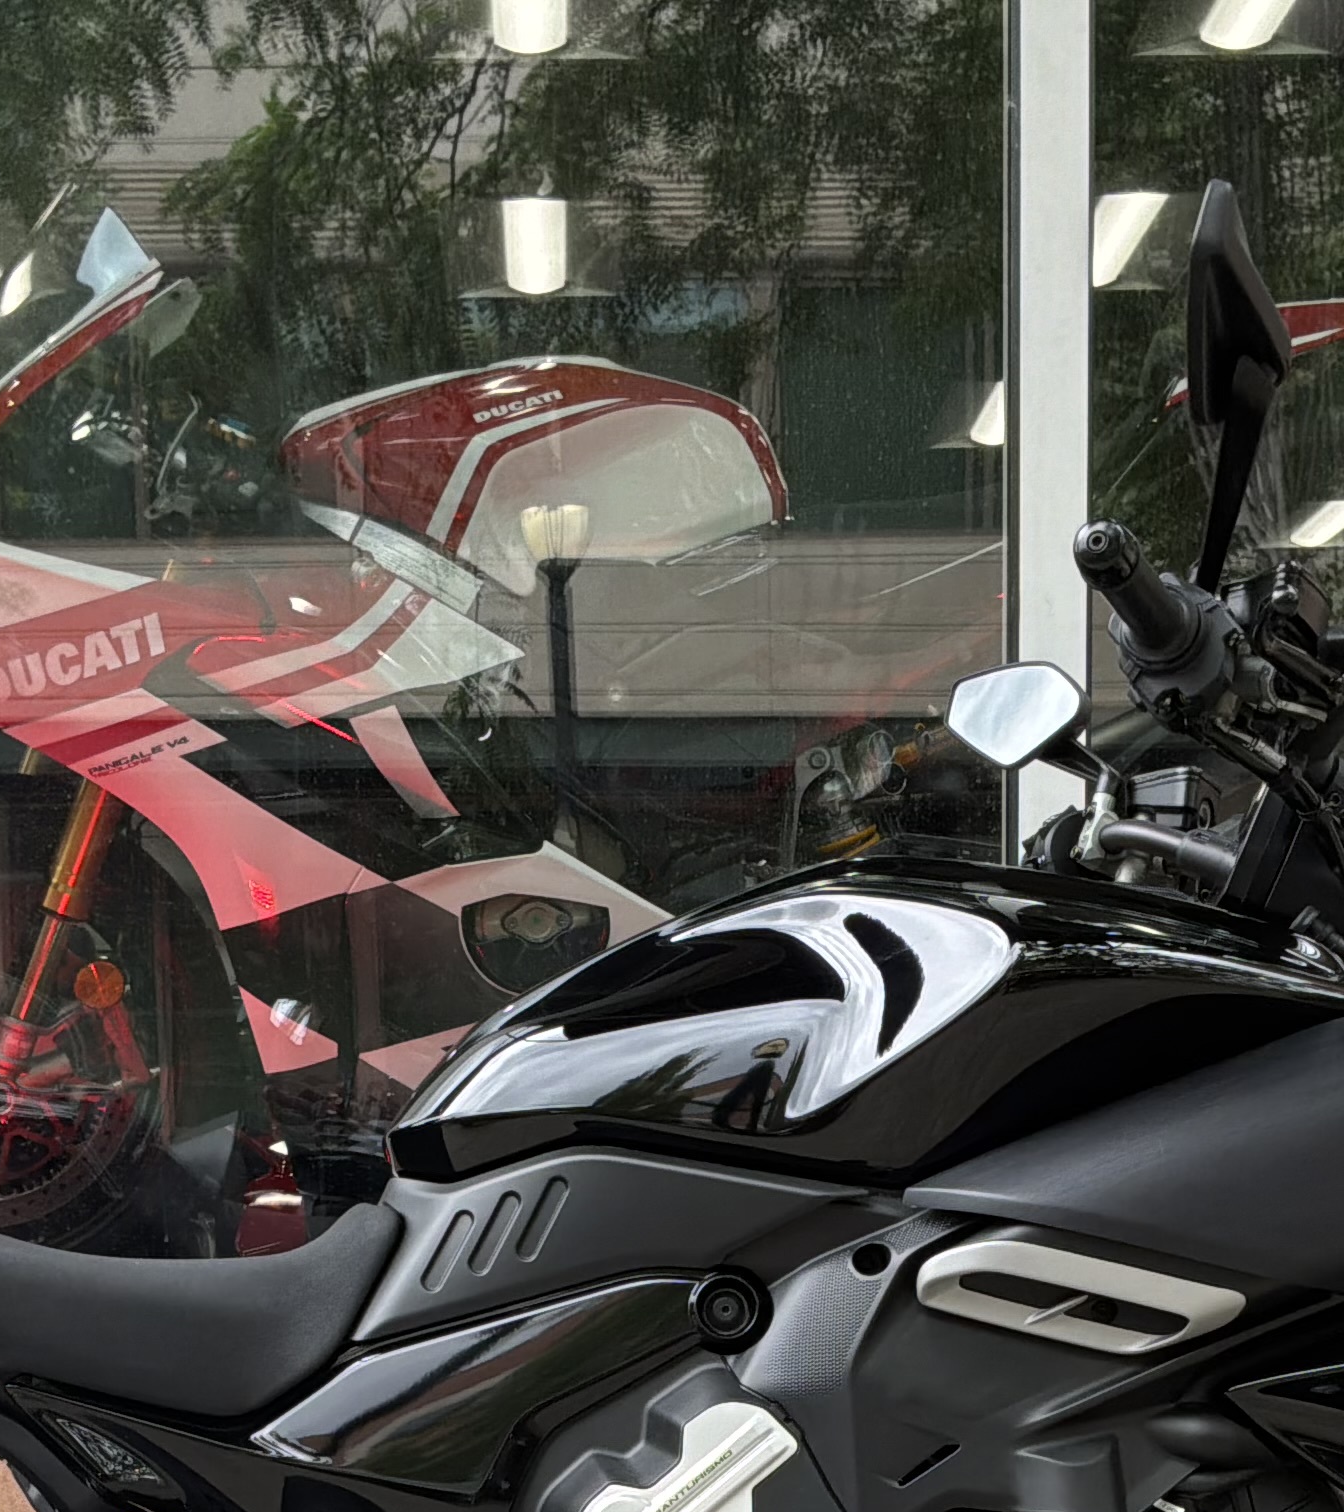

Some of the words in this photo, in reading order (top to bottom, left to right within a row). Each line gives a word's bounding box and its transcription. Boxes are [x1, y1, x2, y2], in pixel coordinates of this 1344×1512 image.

[472, 389, 564, 424] DUCATI
[88, 743, 164, 775] PANIGALE
[166, 736, 191, 750] V4
